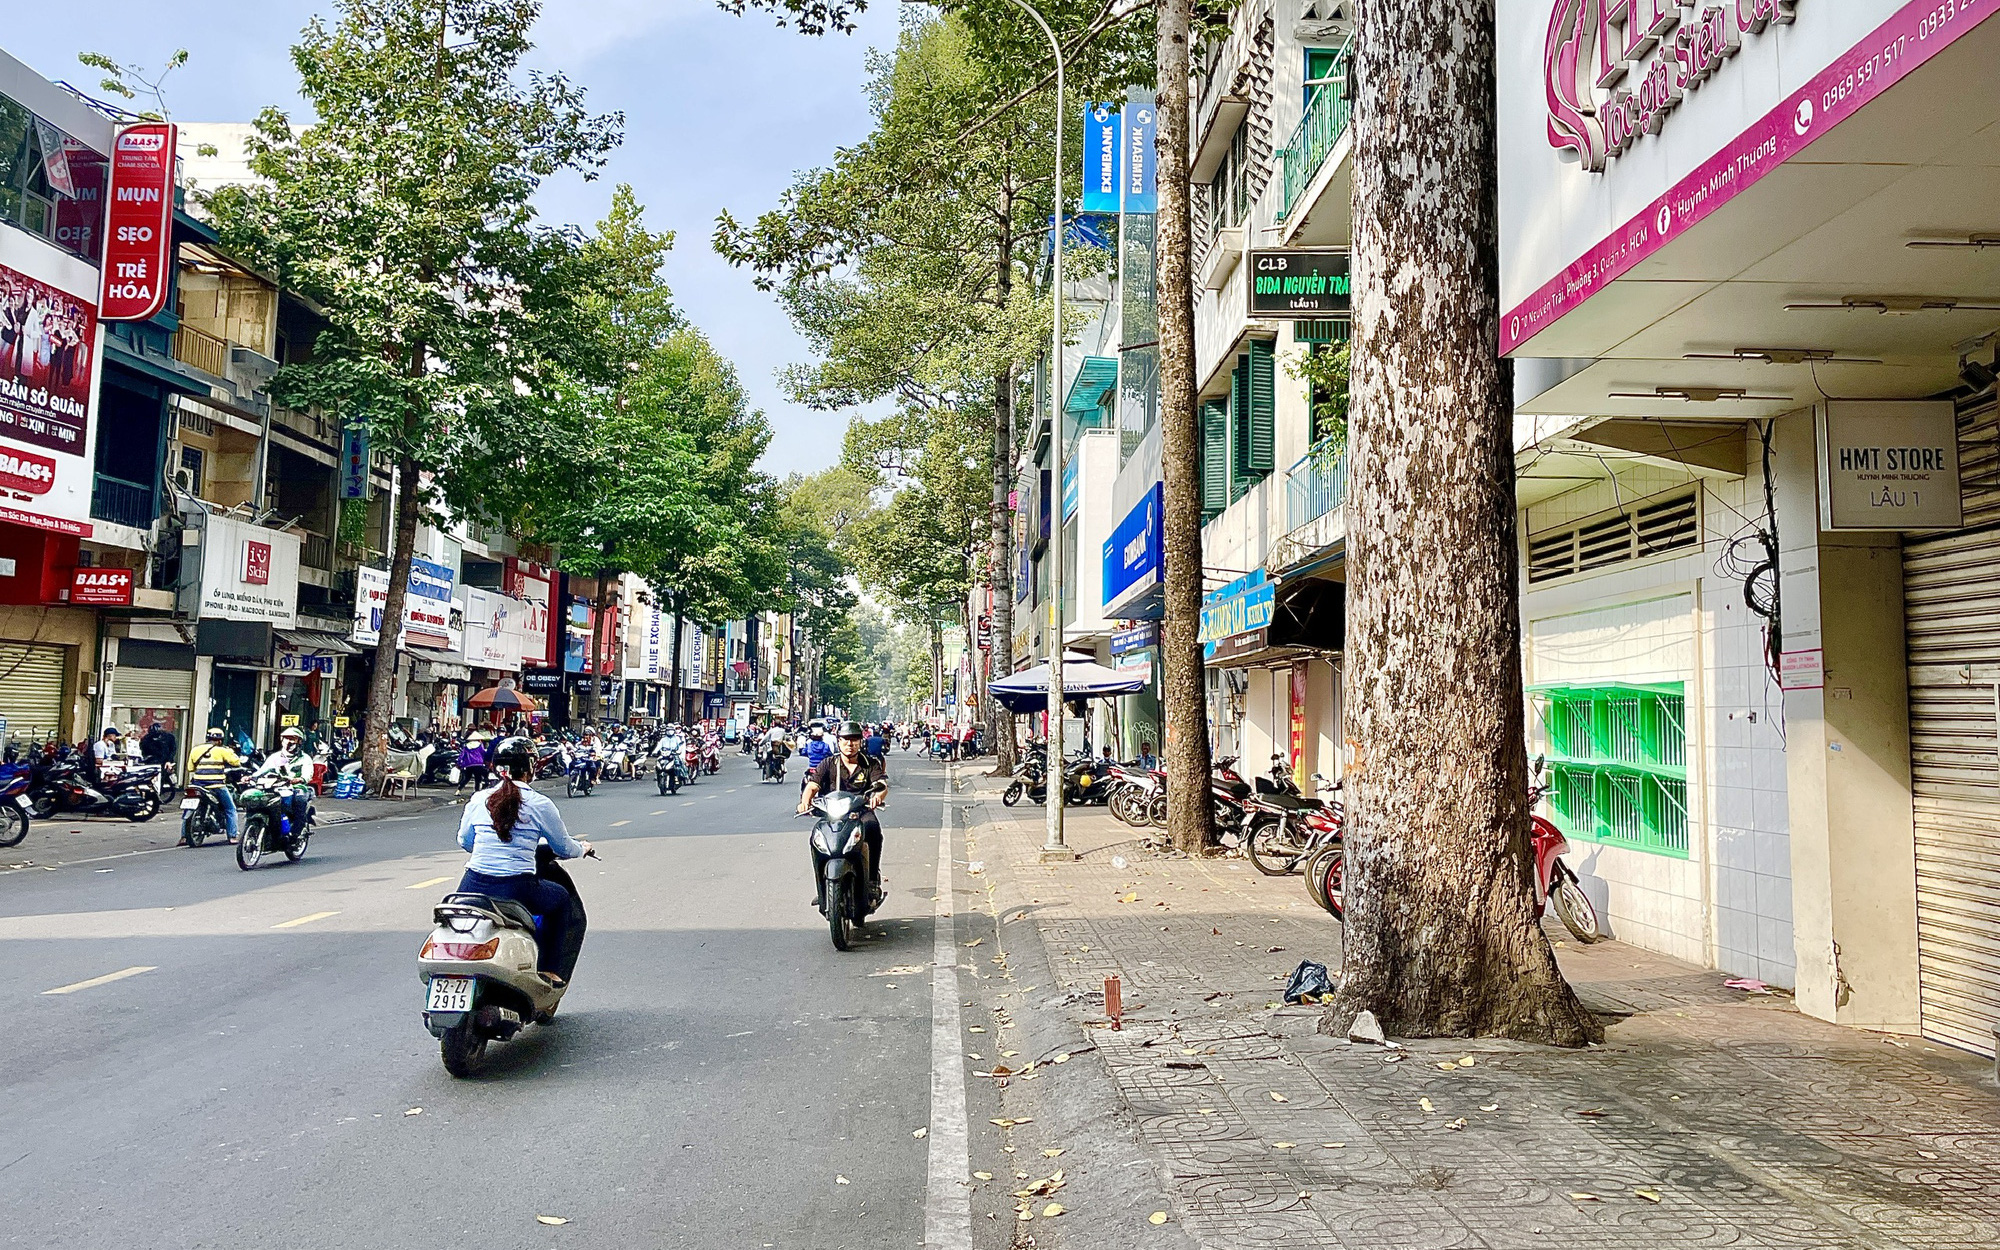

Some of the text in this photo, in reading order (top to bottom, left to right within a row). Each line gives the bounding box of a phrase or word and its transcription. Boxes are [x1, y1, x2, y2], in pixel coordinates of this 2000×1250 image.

[1822, 74, 1853, 112] 0969
[1857, 56, 1880, 85] 597
[1883, 34, 1906, 67] 517
[1919, 0, 1955, 41] 0933
[1101, 125, 1113, 194] EXIMBANK
[1709, 163, 1735, 195] Minh
[117, 187, 160, 206] MỤN
[117, 226, 153, 245] SẸO
[1629, 226, 1648, 252] HCM
[116, 258, 148, 279] TRẺ
[1257, 257, 1288, 271] CLB
[108, 280, 152, 299] HÓA
[1256, 268, 1351, 295] BIDA NGUYỄN TRÃ
[29, 386, 49, 407] SỞ
[49, 396, 85, 418] QUÂN
[0, 452, 52, 482] BAAS+
[1840, 447, 1945, 471] HMT STORE
[1870, 485, 1919, 508] LẦU 1
[75, 573, 129, 586] BAAS+
[248, 565, 267, 579] Skin
[204, 601, 224, 610] IPHONE
[241, 606, 265, 616] MACBOOK
[648, 648, 659, 675] BLUE
[692, 624, 702, 684] BLUE EXCHANG
[436, 980, 468, 993] 52-27
[433, 995, 467, 1008] 2915
